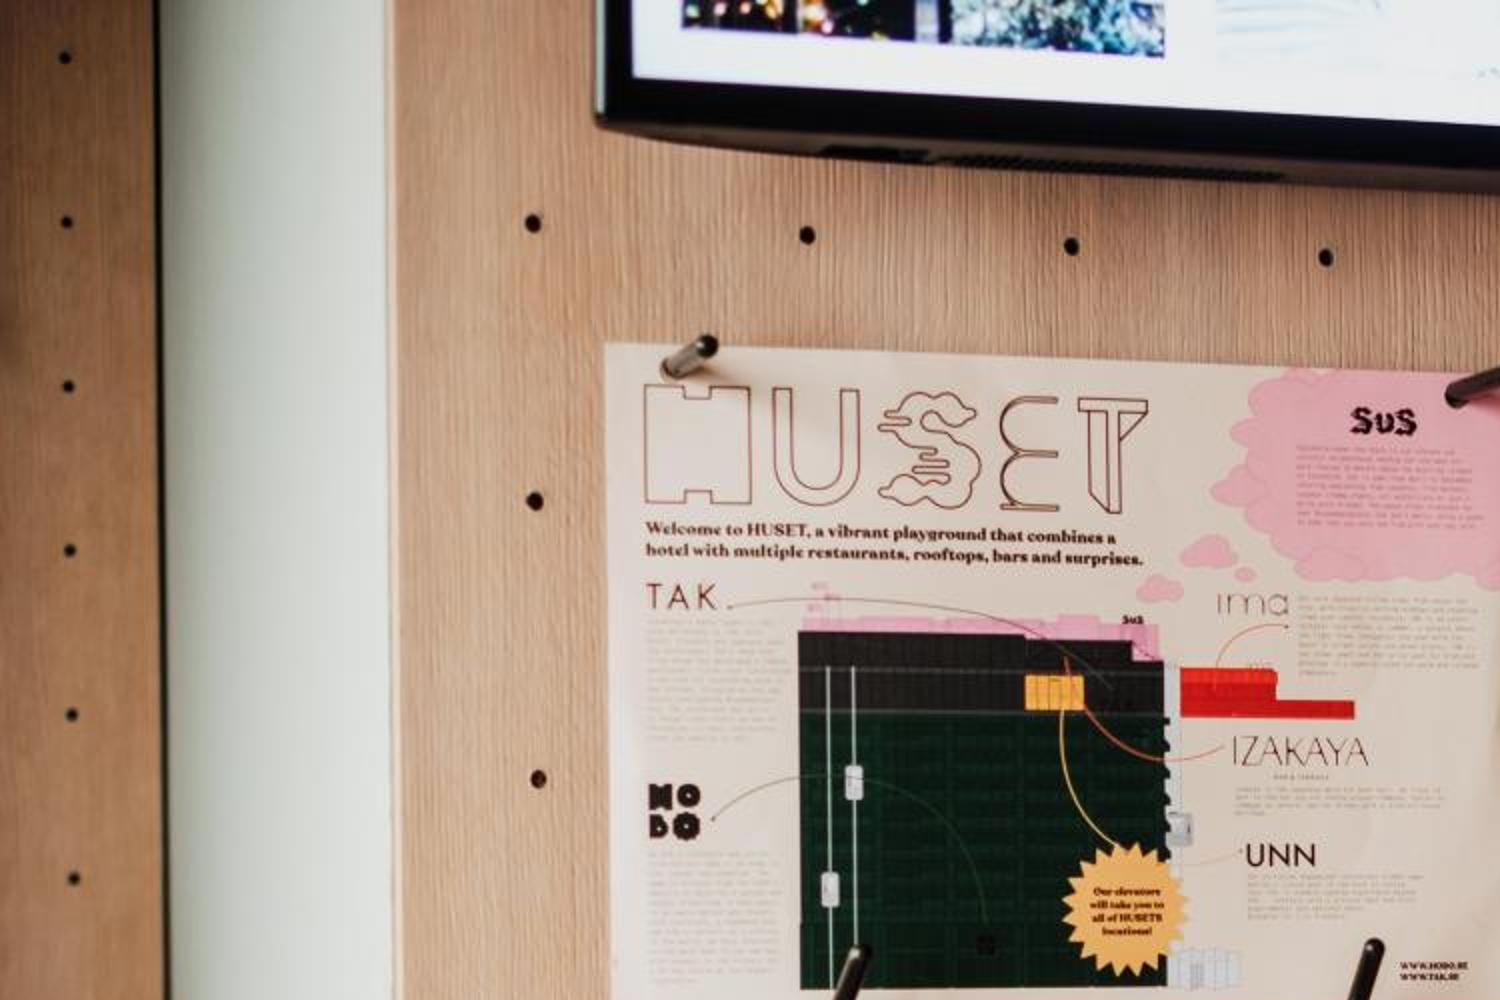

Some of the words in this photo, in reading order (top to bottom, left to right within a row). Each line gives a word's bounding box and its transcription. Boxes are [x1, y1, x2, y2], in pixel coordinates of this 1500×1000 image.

[644, 384, 1149, 514] HUSET
[646, 522, 721, 535] Welcome
[726, 525, 742, 535] to
[748, 523, 811, 538] HUSET,
[816, 528, 824, 537] a
[829, 525, 888, 538] vibrant
[894, 526, 986, 542] playground
[991, 528, 1022, 541] that
[1027, 530, 1103, 543] combines
[1108, 535, 1116, 544] a
[646, 543, 688, 556] hotel
[694, 544, 729, 556] with
[734, 544, 803, 560] multiple
[808, 549, 909, 560] restaurants,
[914, 548, 988, 565] rooftops,
[992, 548, 1029, 561] bars
[1031, 549, 1062, 563] and
[1066, 552, 1142, 568] surprises.
[646, 584, 717, 610] TAK
[1233, 736, 1369, 767] IZAKAYA
[1246, 843, 1317, 868] UNN
